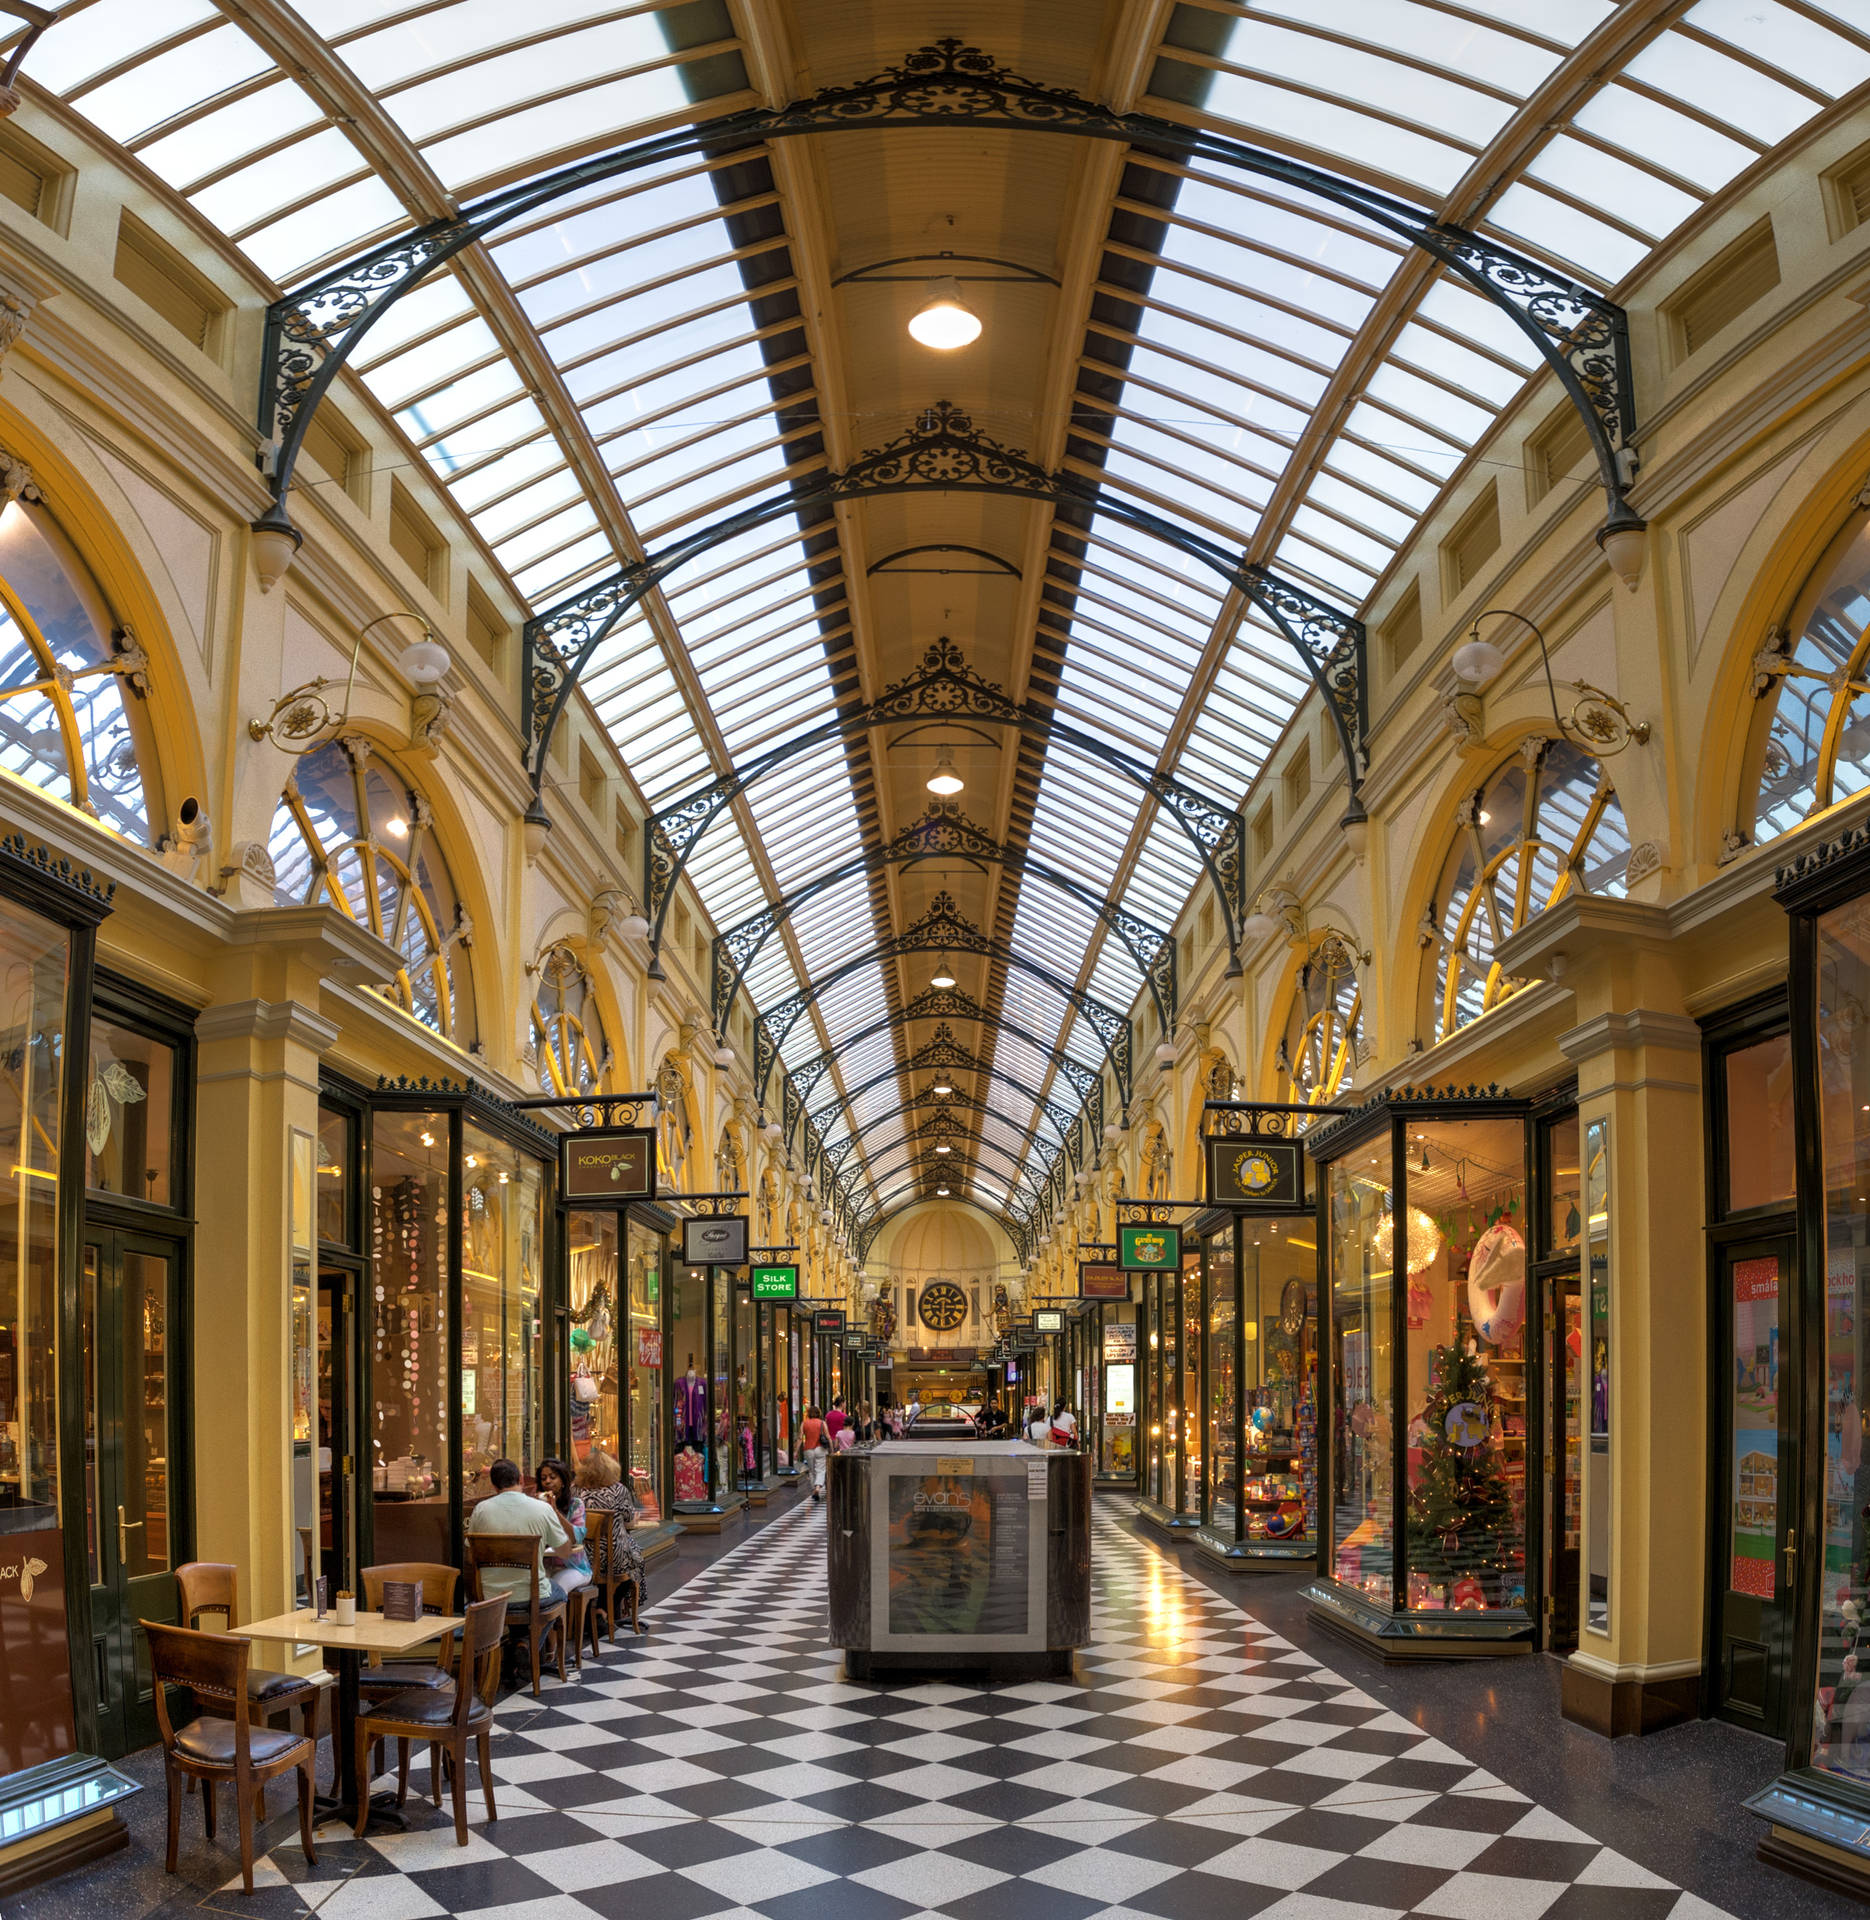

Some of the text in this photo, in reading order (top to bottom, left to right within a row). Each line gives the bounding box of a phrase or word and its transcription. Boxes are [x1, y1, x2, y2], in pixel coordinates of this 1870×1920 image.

[578, 1154, 611, 1166] KOKO
[1232, 1150, 1279, 1175] JASPER JUNIOR
[763, 1274, 786, 1282] SILK
[757, 1283, 792, 1291] STORE
[913, 1491, 971, 1507] evans
